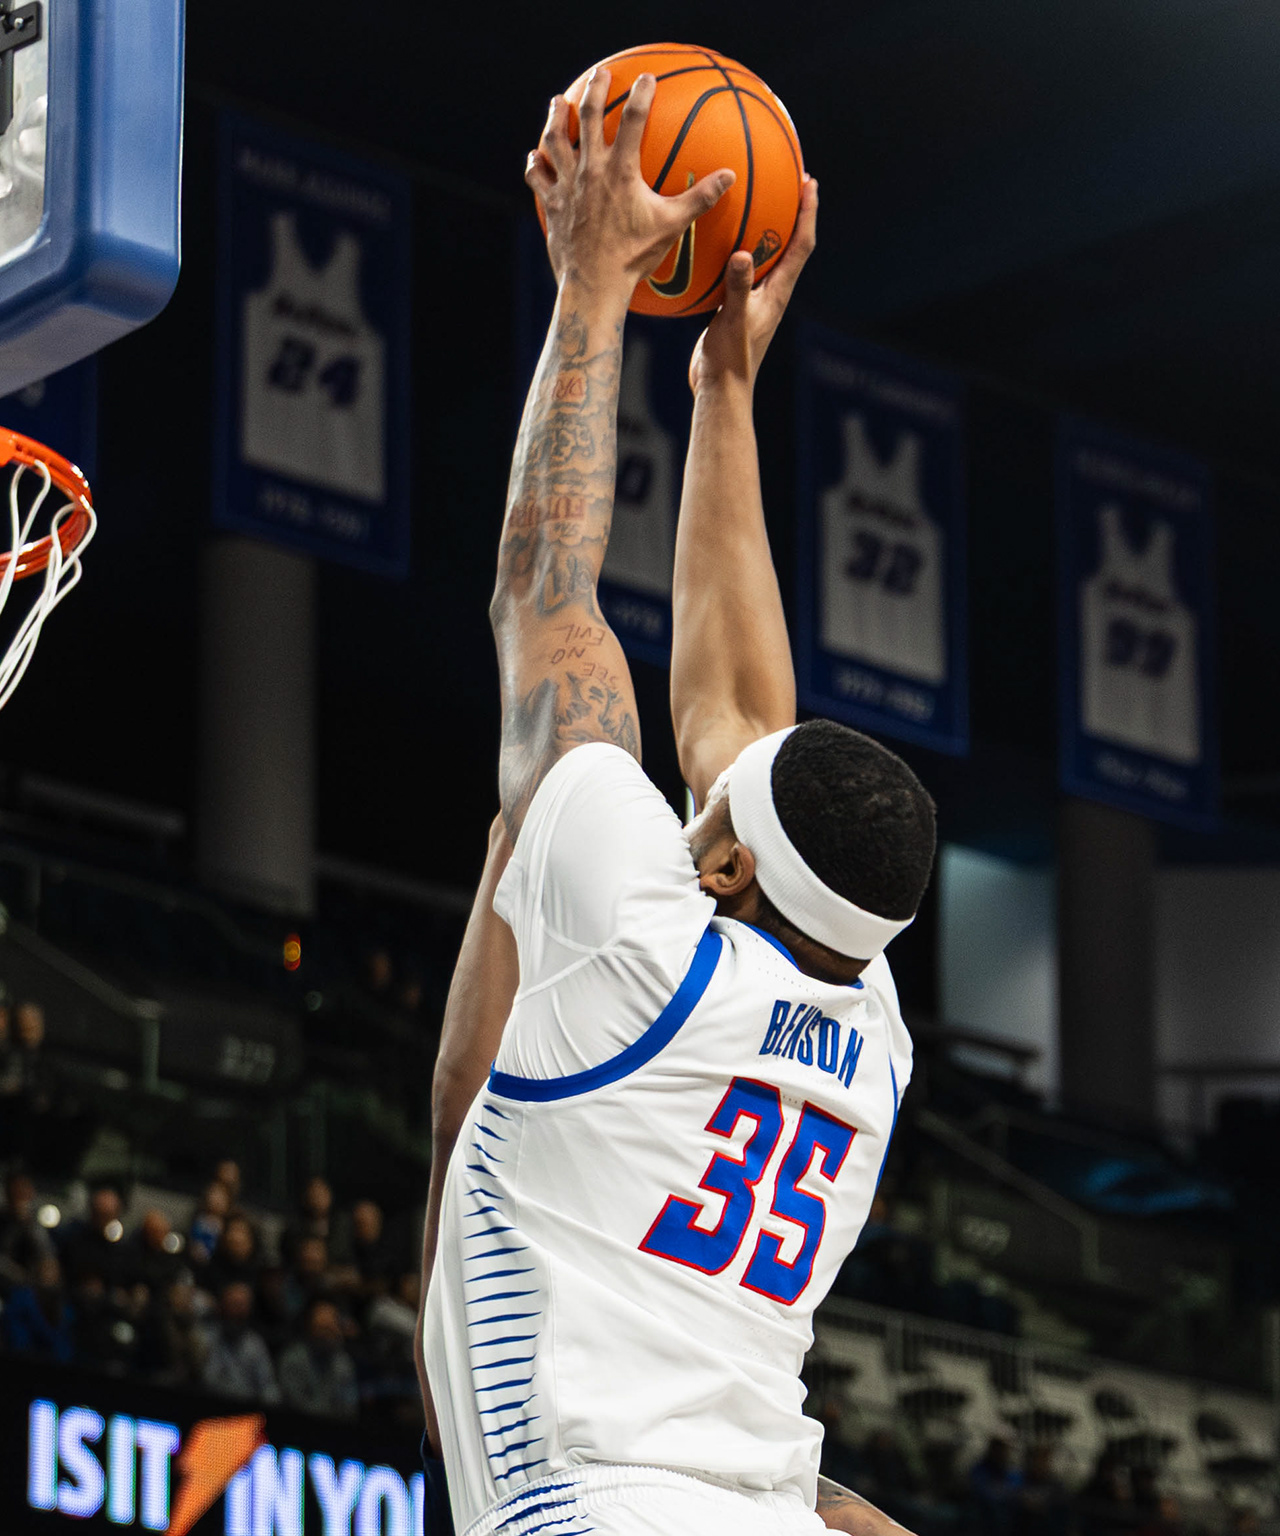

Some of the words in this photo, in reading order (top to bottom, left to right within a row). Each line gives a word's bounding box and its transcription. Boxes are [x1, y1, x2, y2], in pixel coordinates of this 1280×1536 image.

[268, 336, 361, 409] 24
[550, 624, 606, 647] EVIL
[550, 647, 587, 665] NO
[580, 661, 619, 690] SEE
[758, 998, 865, 1090] BENSON
[637, 1075, 858, 1306] 35
